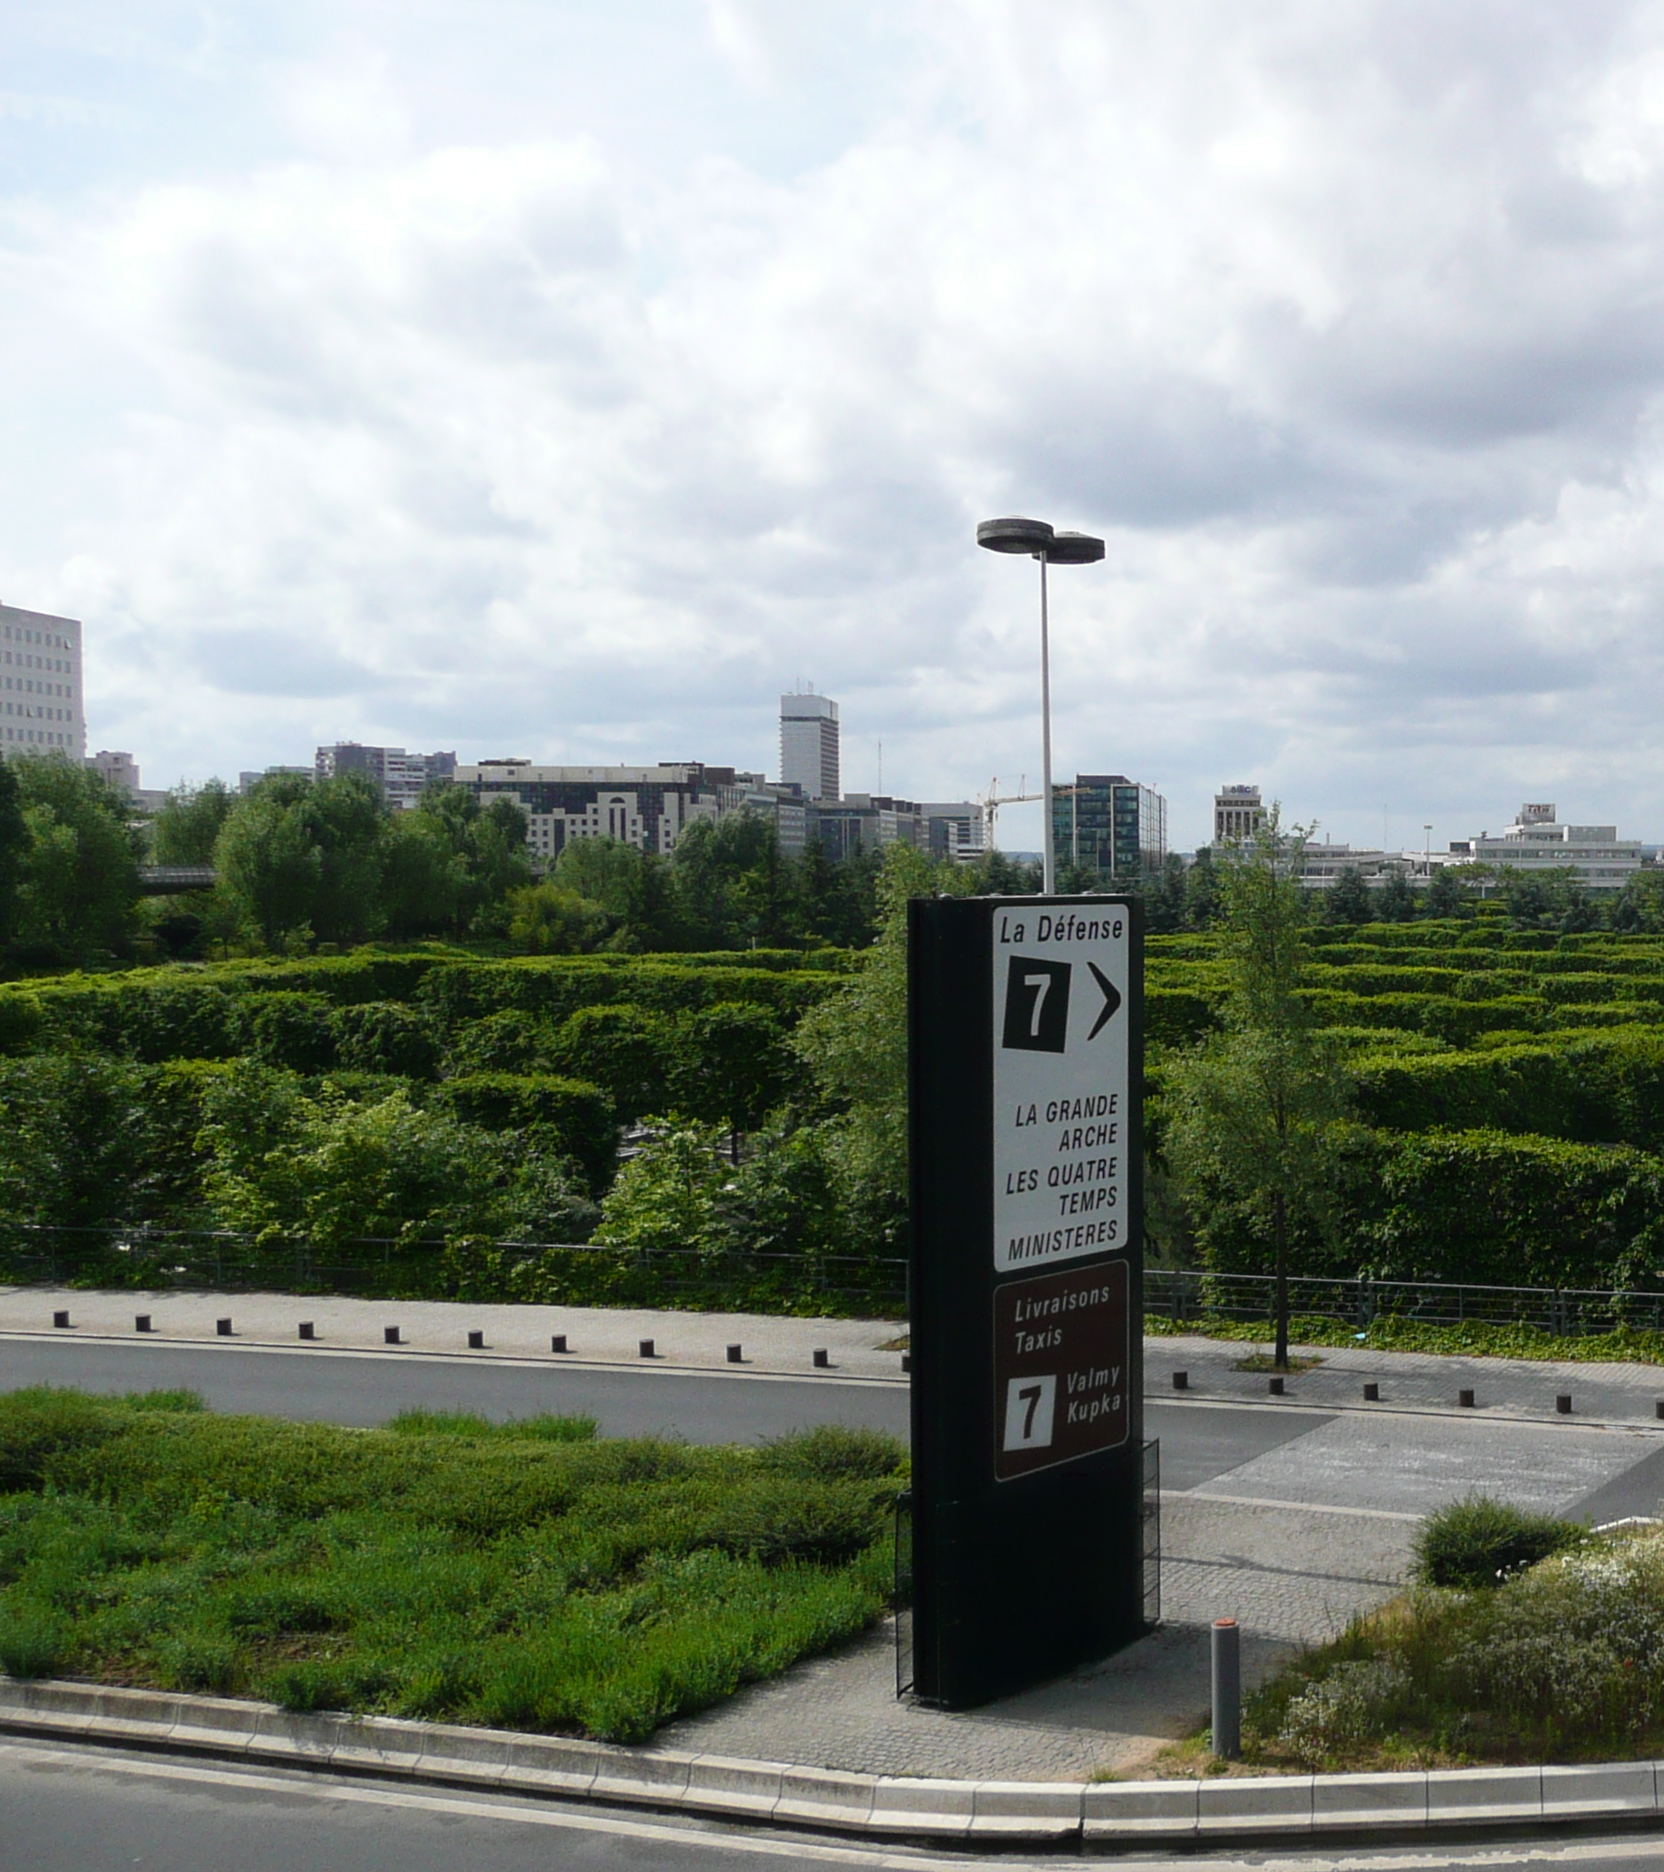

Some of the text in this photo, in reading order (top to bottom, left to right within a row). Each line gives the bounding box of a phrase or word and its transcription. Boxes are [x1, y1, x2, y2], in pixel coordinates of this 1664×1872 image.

[1000, 914, 1123, 943] La Défense
[1024, 974, 1051, 1037] 7
[1015, 1093, 1118, 1127] LA GRANDE
[1058, 1123, 1118, 1152] ARCHE
[1006, 1157, 1118, 1195] LES QUATRE
[1059, 1186, 1118, 1216] TEMPS
[1008, 1220, 1118, 1261] MINISTERES
[1015, 1286, 1110, 1322] Livraisons
[1015, 1325, 1063, 1355] Taxis
[1067, 1365, 1120, 1394] Valmy
[1018, 1385, 1042, 1440] 7
[1067, 1393, 1121, 1424] Kupka
